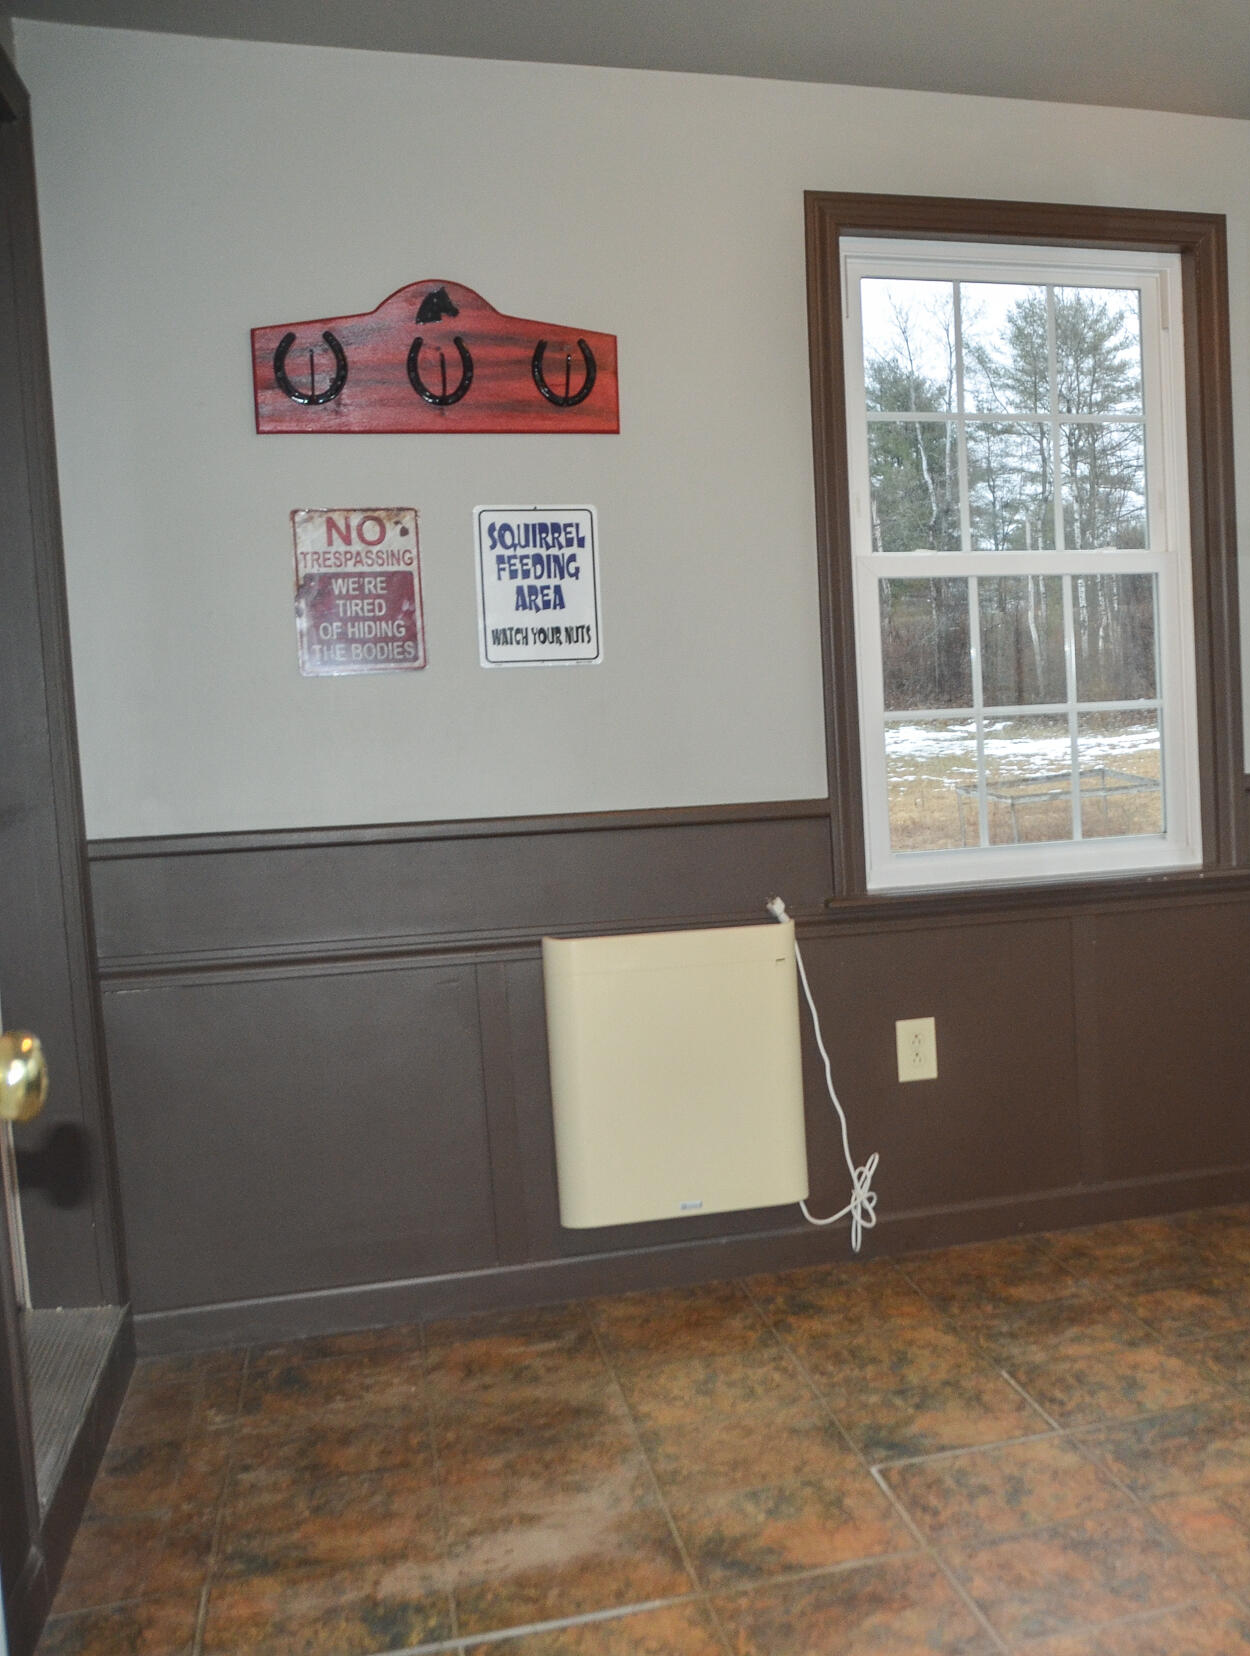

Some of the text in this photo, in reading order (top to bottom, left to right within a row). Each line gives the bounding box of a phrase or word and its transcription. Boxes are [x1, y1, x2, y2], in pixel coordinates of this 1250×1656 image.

[326, 515, 386, 547] NO
[487, 522, 585, 552] SQUIRREL
[300, 549, 414, 568] TRESPASSING
[496, 553, 580, 581] FEEDING
[332, 577, 387, 595] WE'RE
[336, 599, 386, 617] TIRED
[515, 584, 565, 613] AREA
[319, 620, 405, 640] OF HIDING
[492, 625, 591, 646] WATCH YOUR NUTS
[312, 641, 415, 661] THE BODIES
